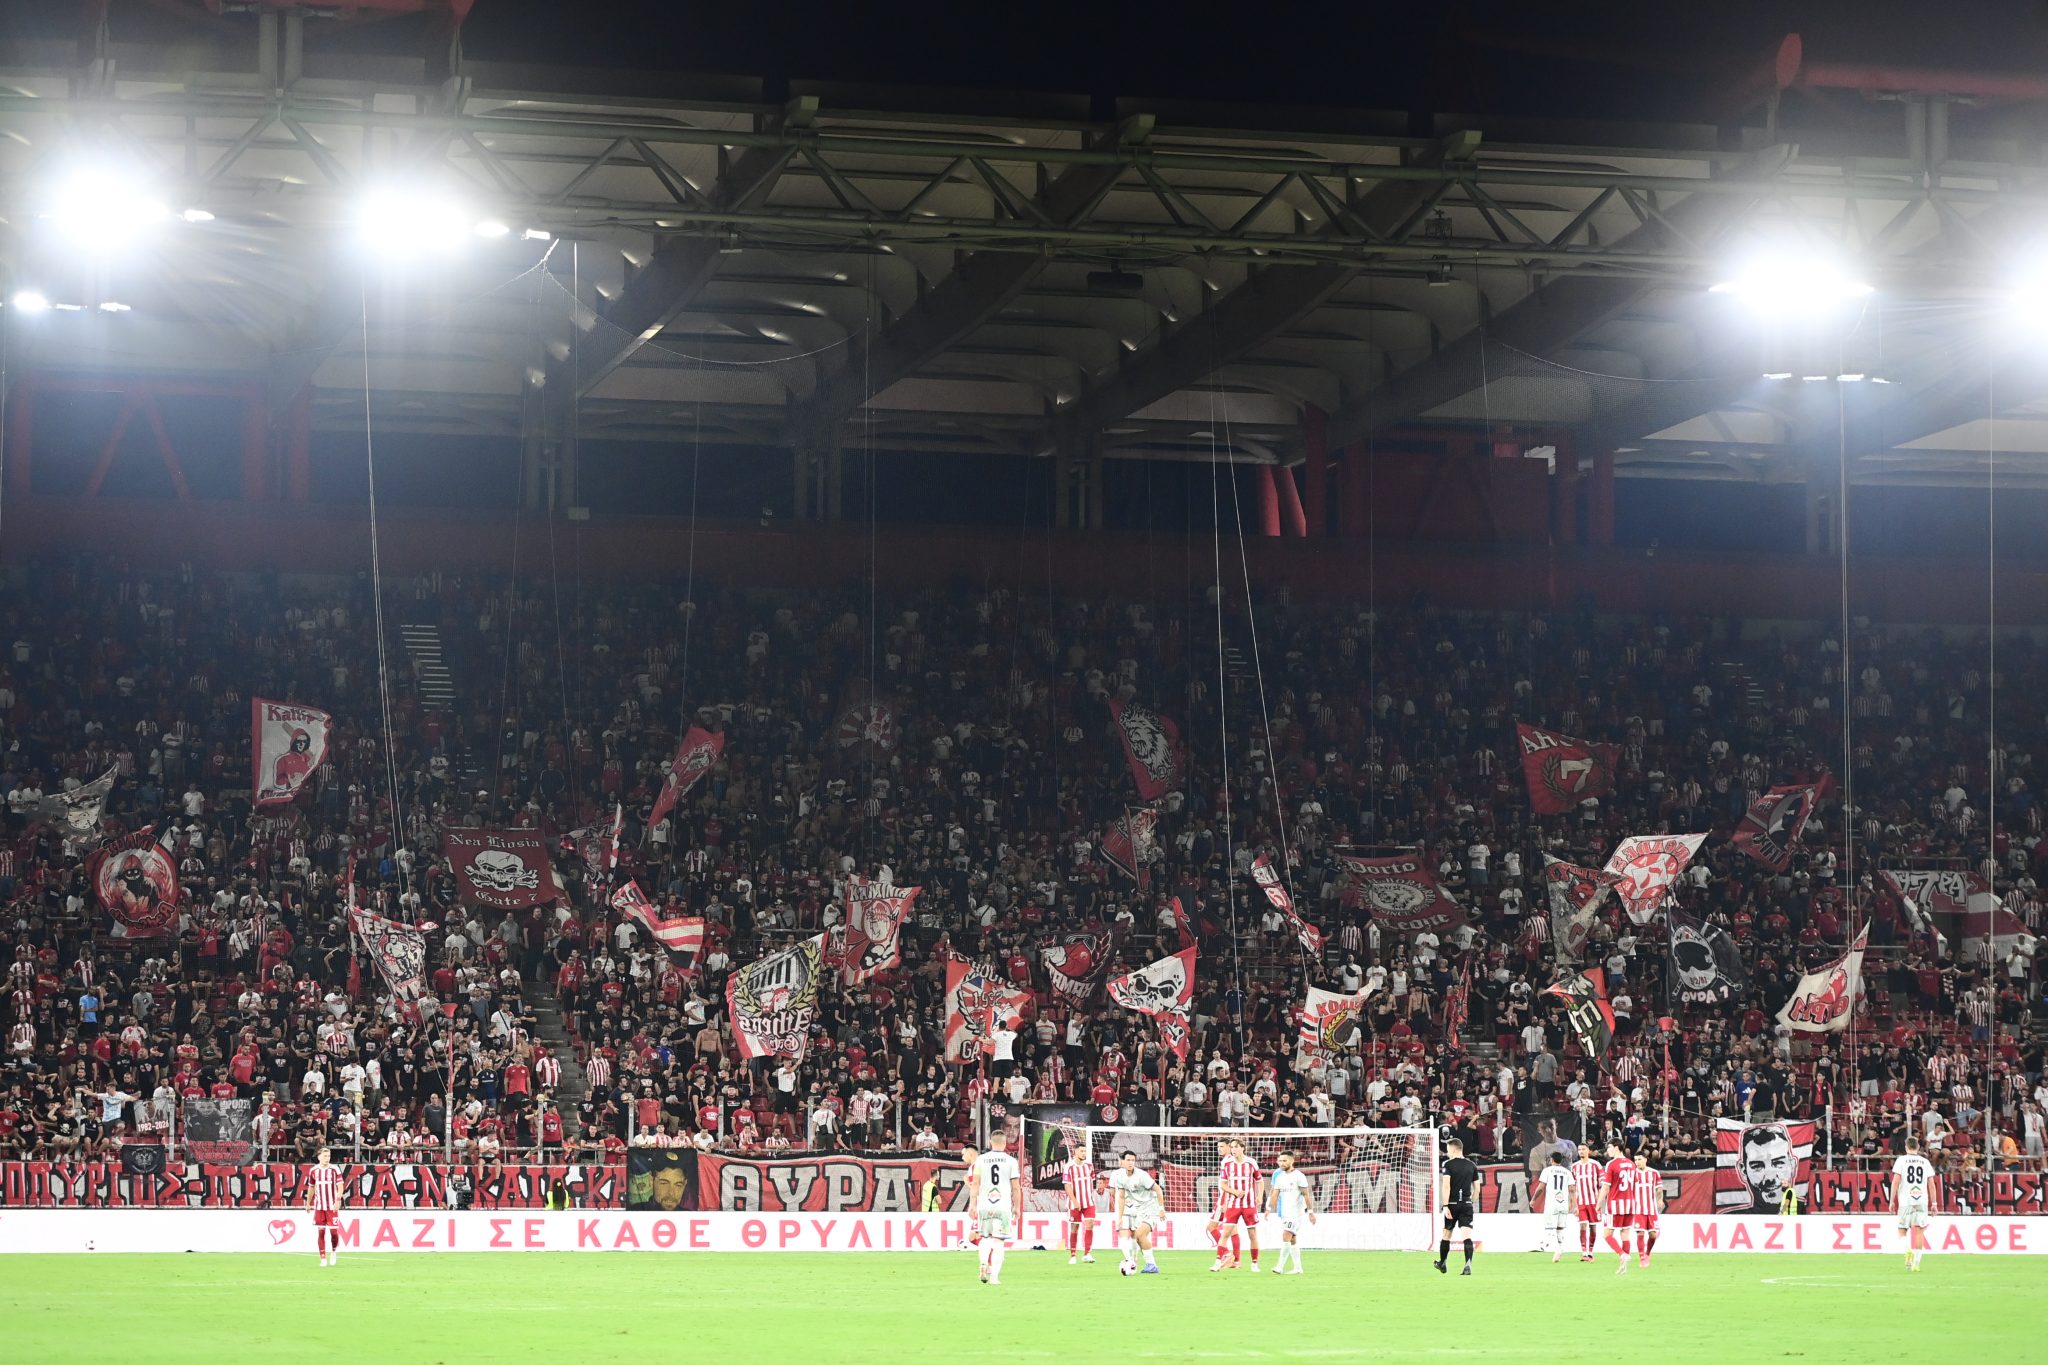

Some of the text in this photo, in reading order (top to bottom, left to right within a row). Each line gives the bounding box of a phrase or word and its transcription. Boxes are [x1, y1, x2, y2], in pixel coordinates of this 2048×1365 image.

[1560, 757, 1594, 792] 7
[448, 834, 540, 848] Nea Liosia
[1344, 860, 1416, 875] Porto
[475, 890, 537, 906] Gate 7
[991, 1164, 1000, 1185] 6
[1553, 1174, 1564, 1191] 11
[1618, 1170, 1635, 1192] 34
[1906, 1165, 1924, 1185] 89
[721, 1162, 913, 1211] ΘΥΡΑ
[338, 1219, 456, 1247] ΜΑΖΙ
[490, 1219, 545, 1247] ΣΕ
[579, 1219, 710, 1248] ΚΑΘΕ
[741, 1219, 963, 1248] ΘΡΥΛΙΚΗ
[1693, 1222, 1801, 1249] ΜΑΖΙ
[1832, 1223, 1881, 1249] ΣΕ
